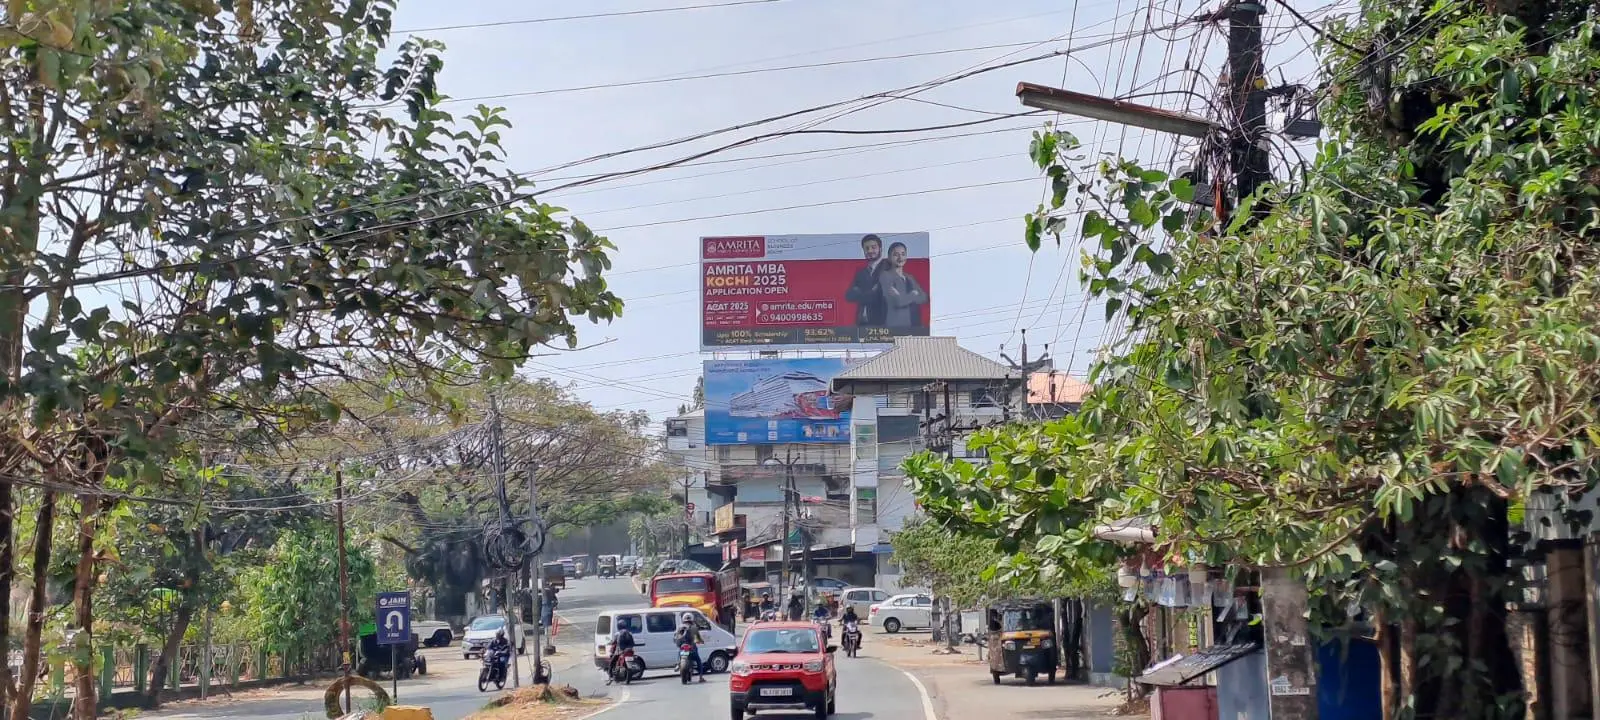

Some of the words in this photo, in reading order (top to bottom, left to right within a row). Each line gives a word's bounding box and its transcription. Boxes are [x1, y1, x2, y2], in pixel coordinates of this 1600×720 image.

[717, 240, 760, 250] AMRITA
[706, 264, 754, 276] AMRITA
[757, 263, 786, 274] MBA
[706, 275, 749, 287] KOCHI
[753, 274, 786, 286] 2025
[706, 287, 763, 296] APPLICATION
[764, 286, 789, 295] OPEN
[730, 301, 749, 311] 2025
[769, 301, 833, 311] amrita.edu/mba
[769, 312, 823, 322] 9400998635
[731, 330, 752, 338] 100%
